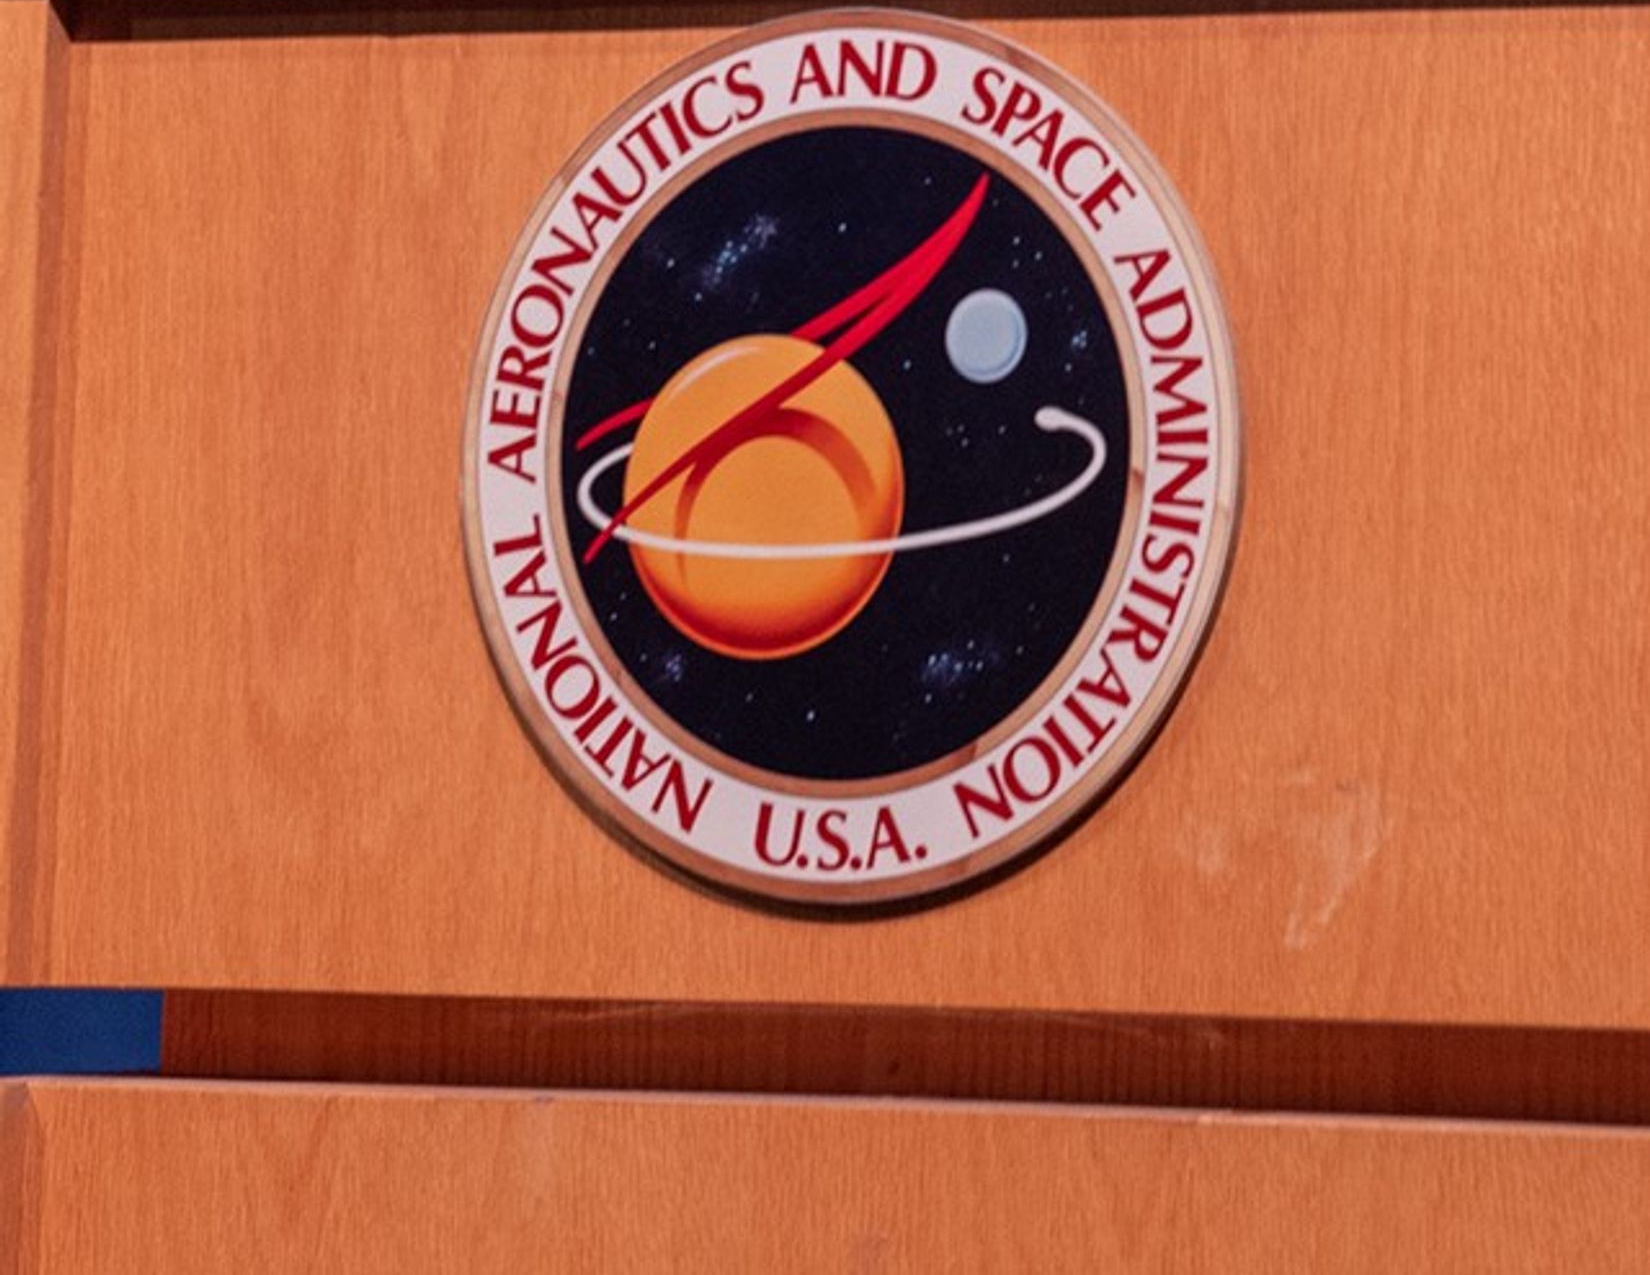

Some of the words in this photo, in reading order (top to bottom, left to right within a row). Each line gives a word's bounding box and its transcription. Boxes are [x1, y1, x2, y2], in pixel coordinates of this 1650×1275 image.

[790, 39, 938, 104] AND
[960, 66, 1136, 232] SPACE
[487, 60, 765, 484] AERONAUTICS
[952, 248, 1210, 839] ADMINISTRATION
[493, 514, 713, 834] NATIONAL
[754, 801, 928, 872] U.S.A.
